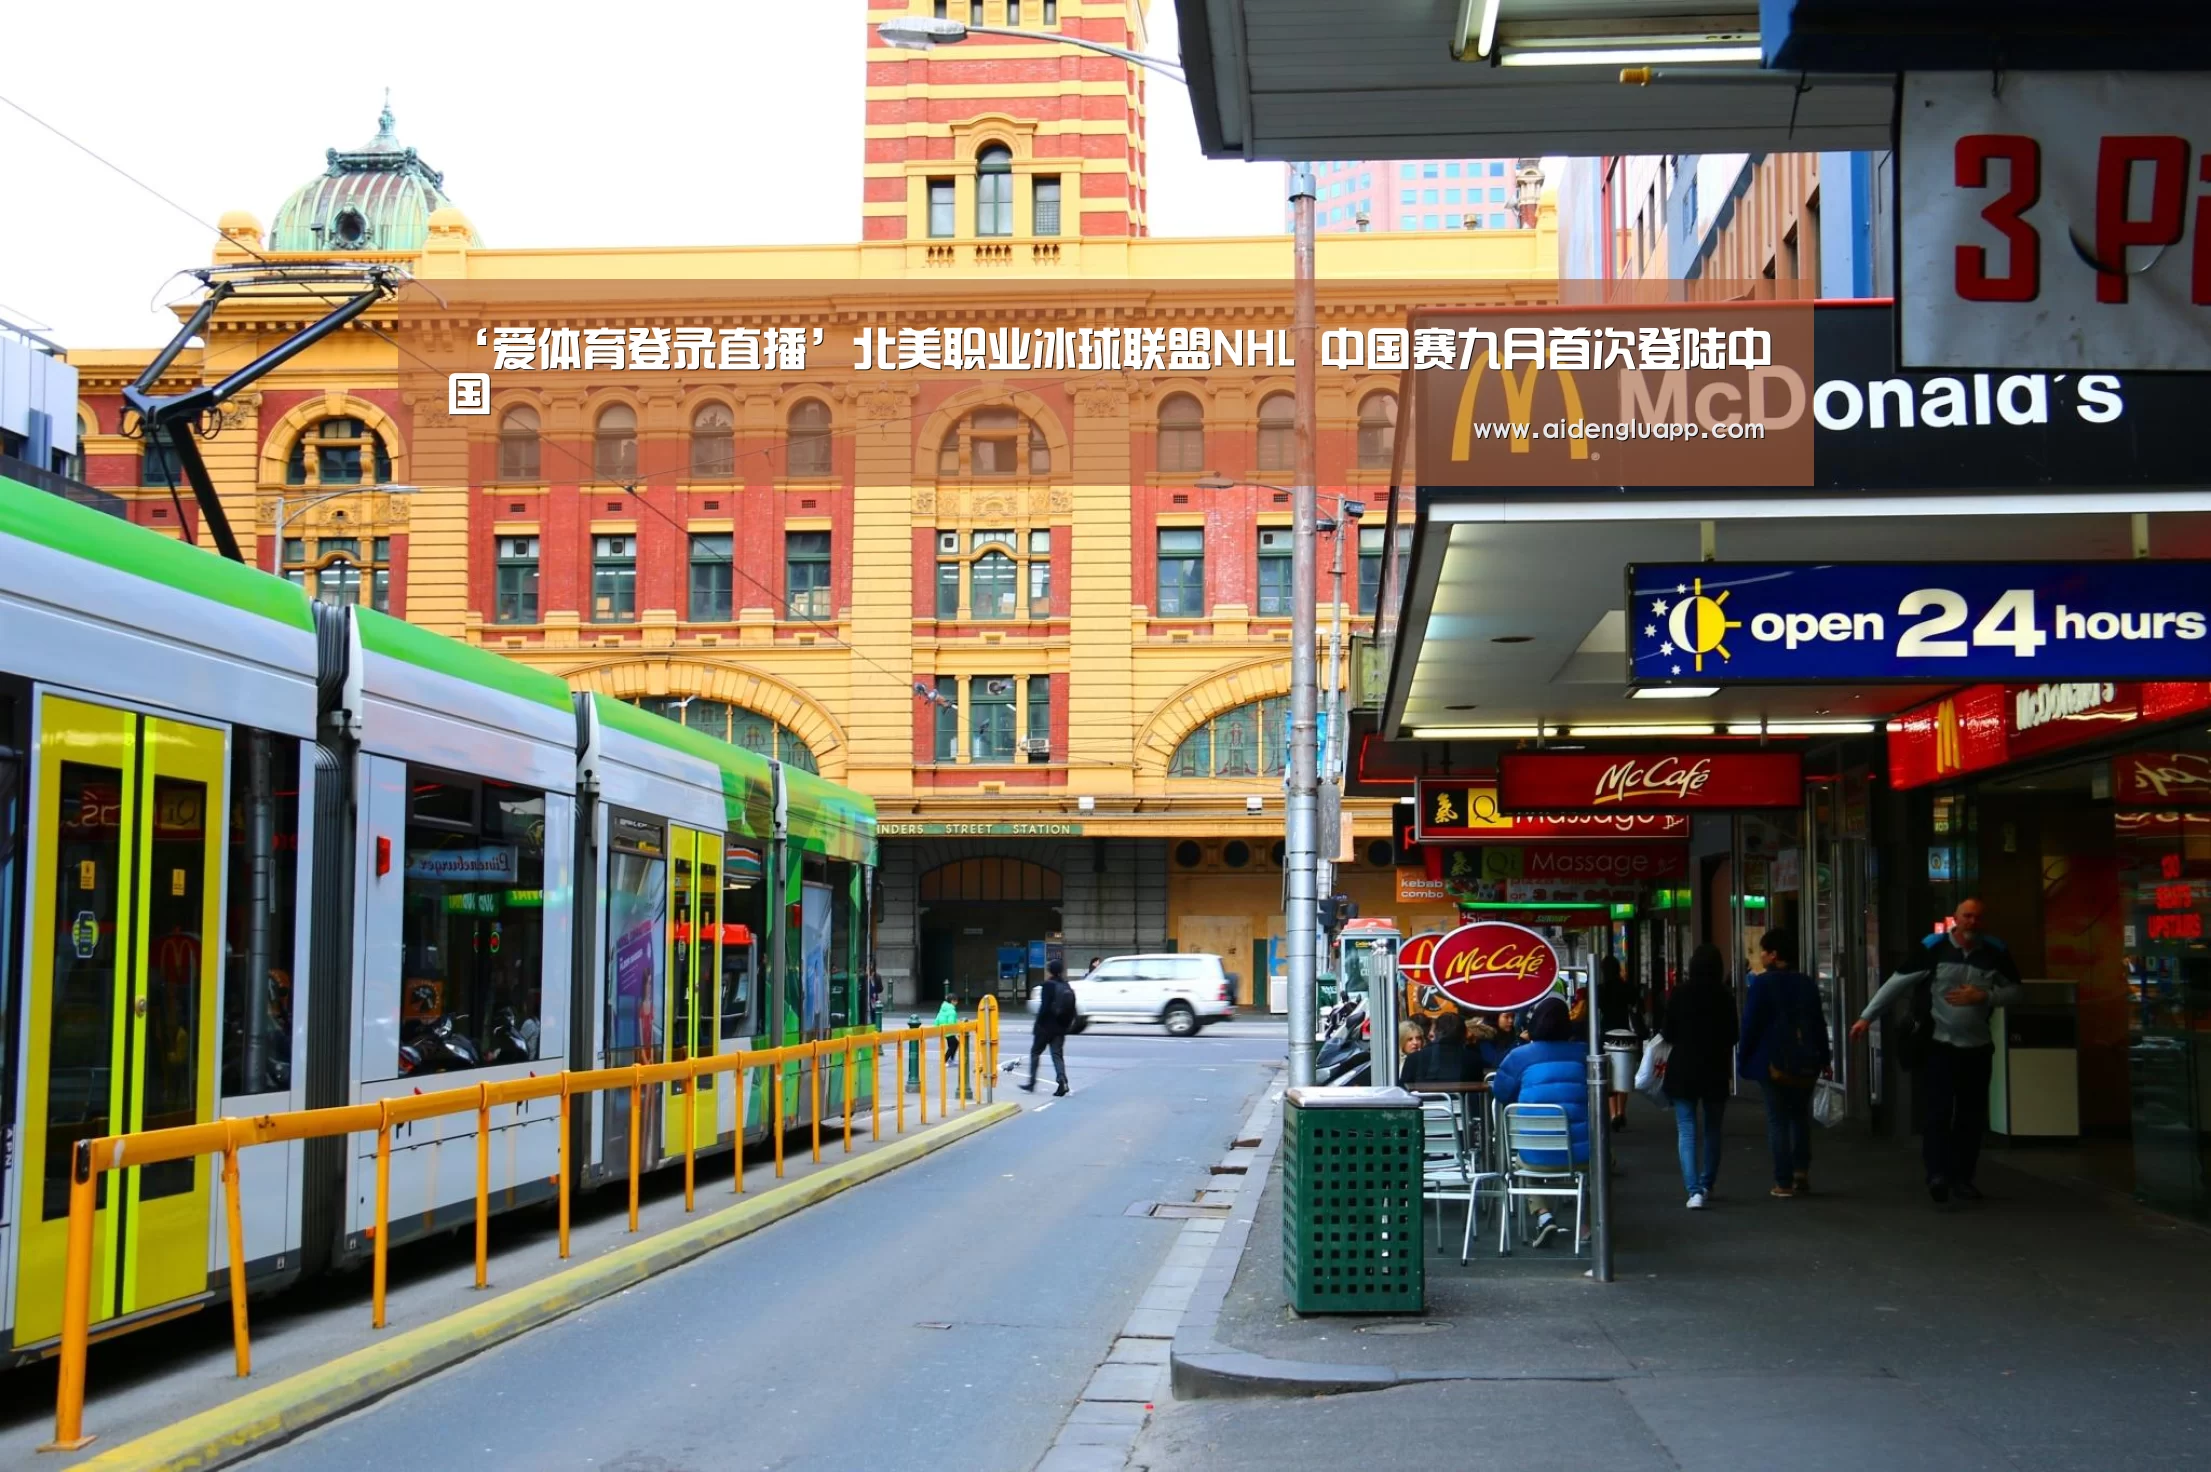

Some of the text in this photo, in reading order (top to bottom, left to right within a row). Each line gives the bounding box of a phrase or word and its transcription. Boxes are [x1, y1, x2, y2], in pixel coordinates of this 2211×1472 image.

[1954, 133, 2041, 303] 3
[1750, 588, 2208, 658] open 24 hours
[1595, 756, 1711, 802] McCafé
[945, 823, 993, 835] STREET
[1012, 823, 1071, 835] STATION
[1531, 852, 1650, 877] Massage
[1400, 878, 1443, 888] kebab
[1400, 889, 1444, 899] combo
[1444, 943, 1545, 984] McCafé
